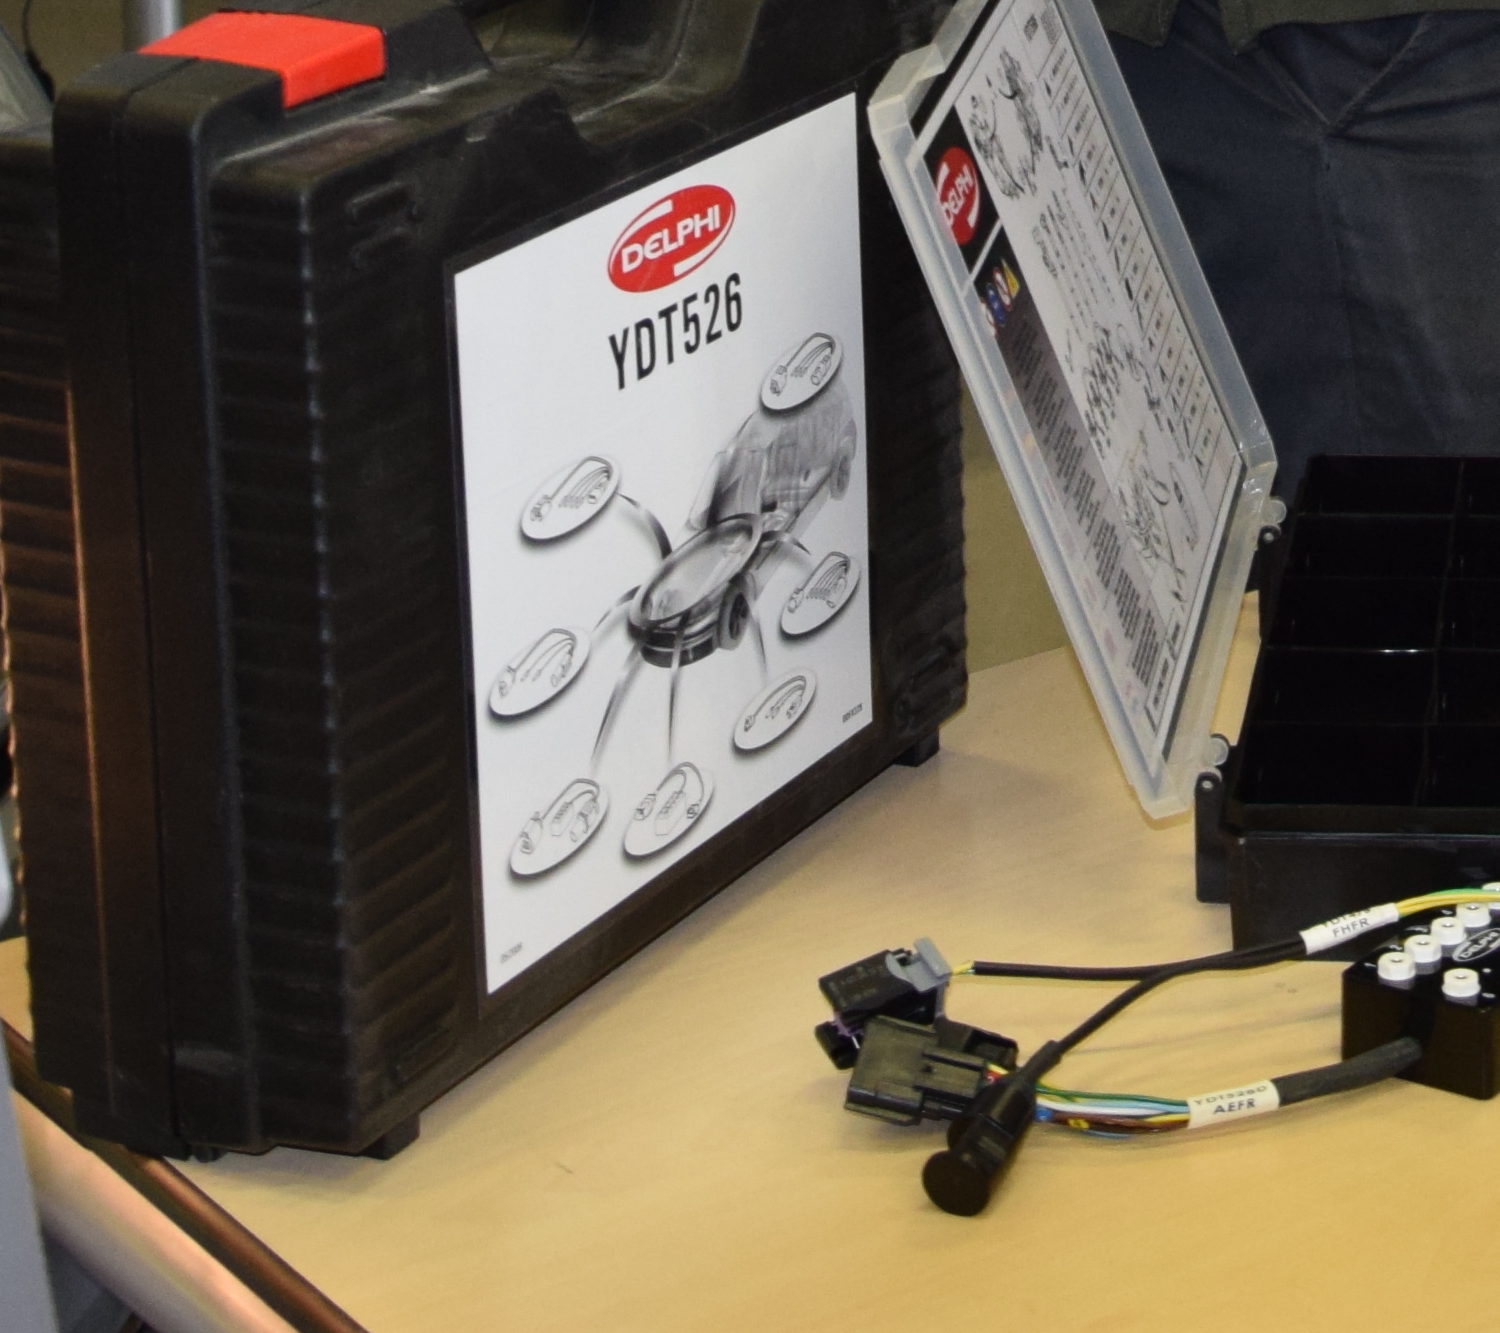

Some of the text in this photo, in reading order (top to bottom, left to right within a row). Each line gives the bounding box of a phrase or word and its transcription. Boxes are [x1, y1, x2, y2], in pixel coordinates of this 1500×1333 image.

[940, 163, 975, 228] DELPHI
[620, 204, 721, 274] DELPHI
[608, 272, 743, 391] YDT526
[1332, 917, 1370, 938] FHFR
[1459, 930, 1500, 959] DELPHI
[1213, 1097, 1256, 1115] AEFR
